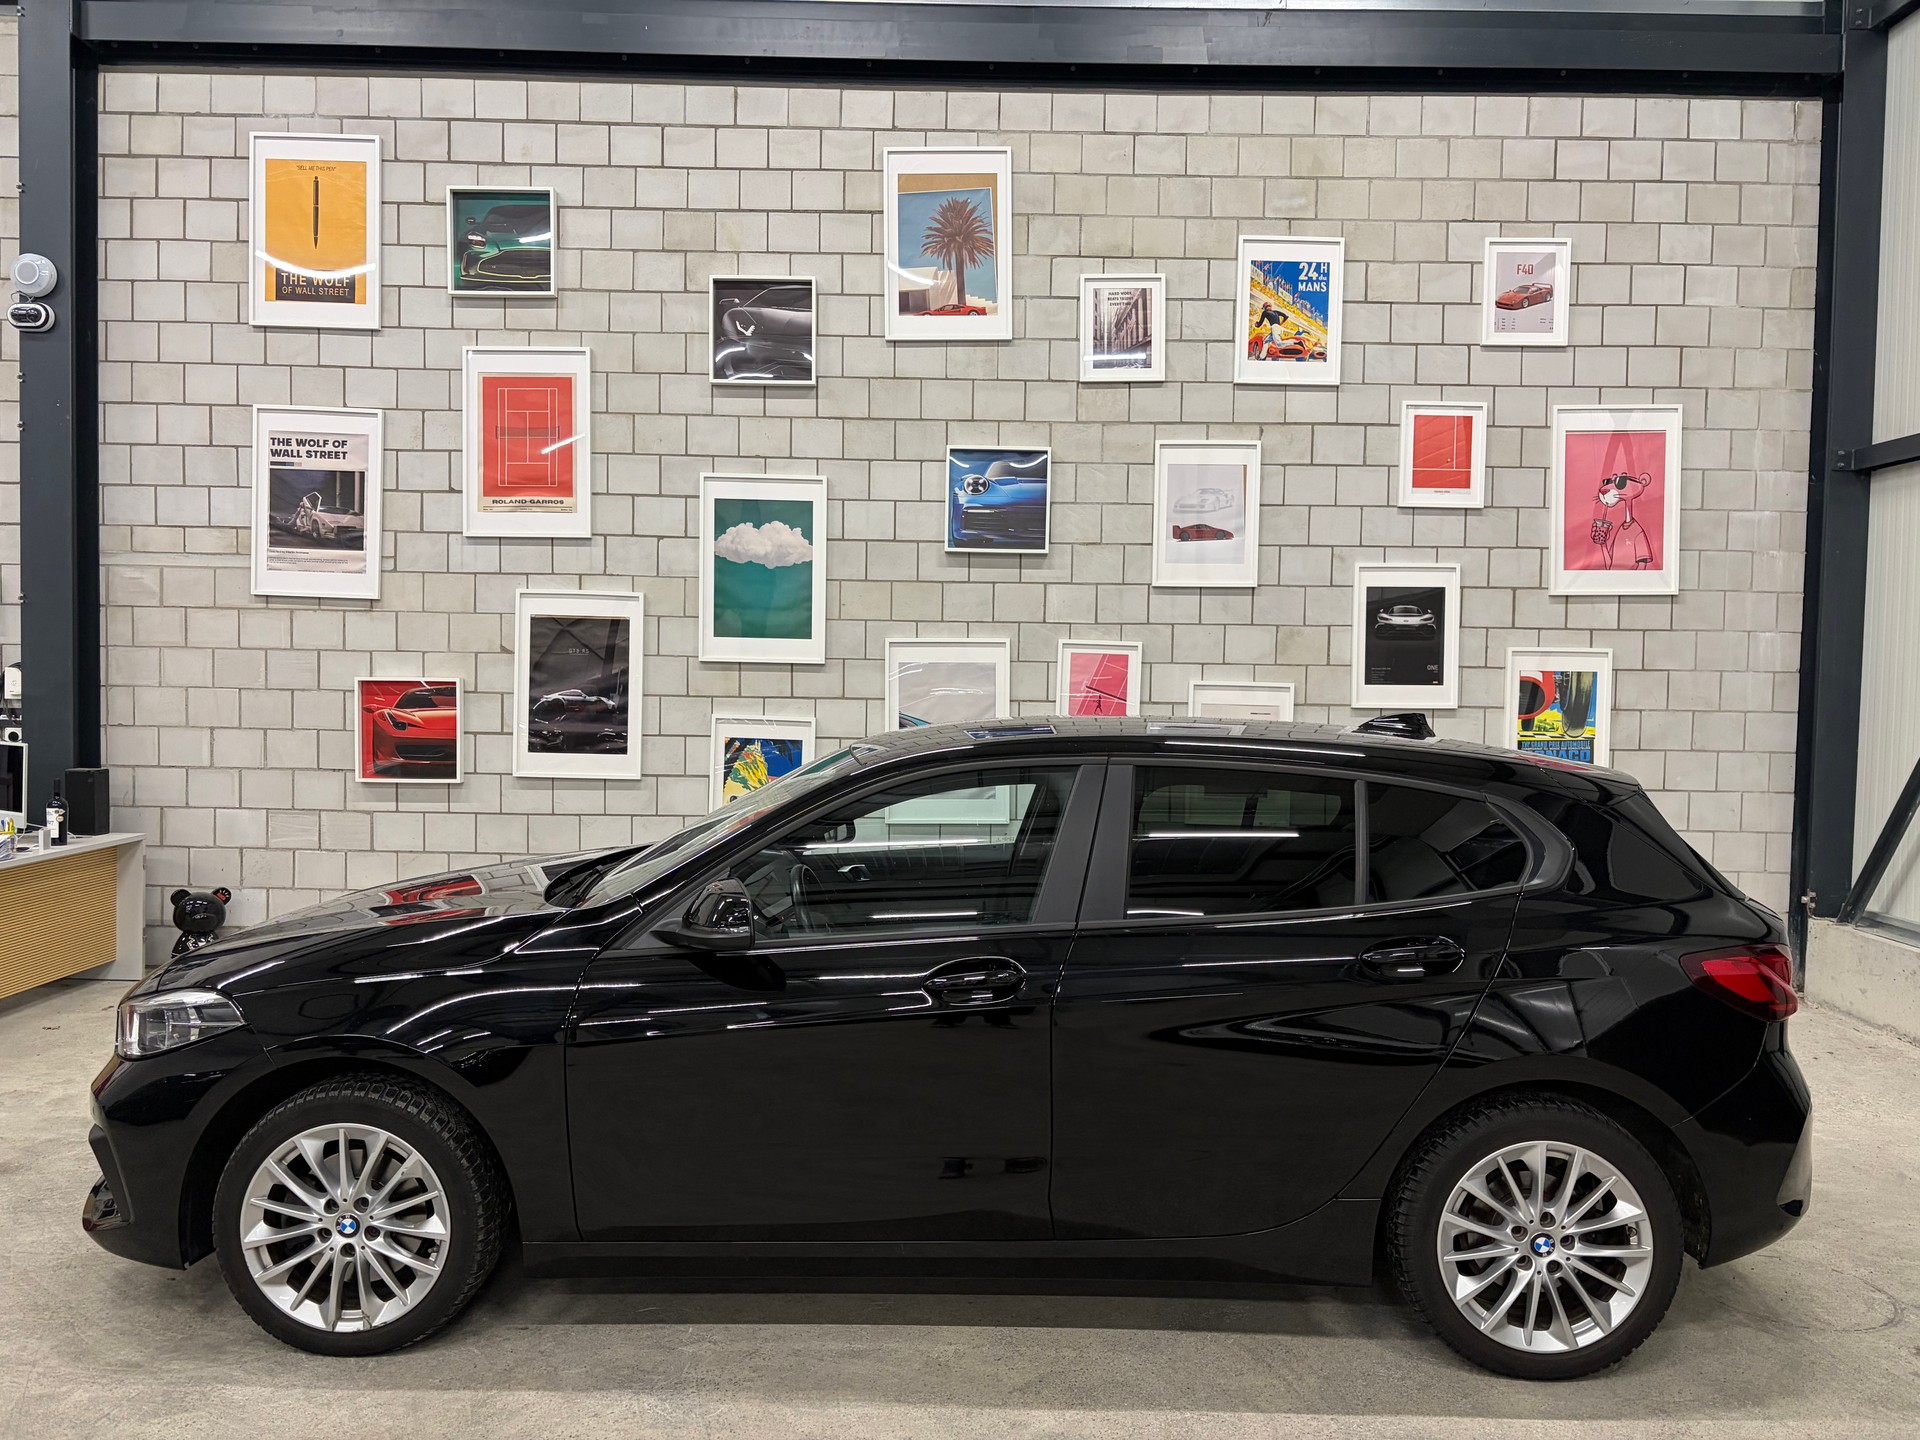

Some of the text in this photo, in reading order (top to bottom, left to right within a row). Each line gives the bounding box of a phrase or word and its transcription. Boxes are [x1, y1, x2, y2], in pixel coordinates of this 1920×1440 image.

[1298, 262, 1328, 280] 24 H
[1516, 264, 1534, 275] F40
[281, 272, 350, 287] THE WOLF
[281, 286, 350, 296] OF WALL STREET
[1298, 282, 1327, 292] MANS
[269, 437, 348, 449] THE WOLF OF
[269, 448, 348, 460] WALL STREET
[1526, 749, 1591, 762] NACO
